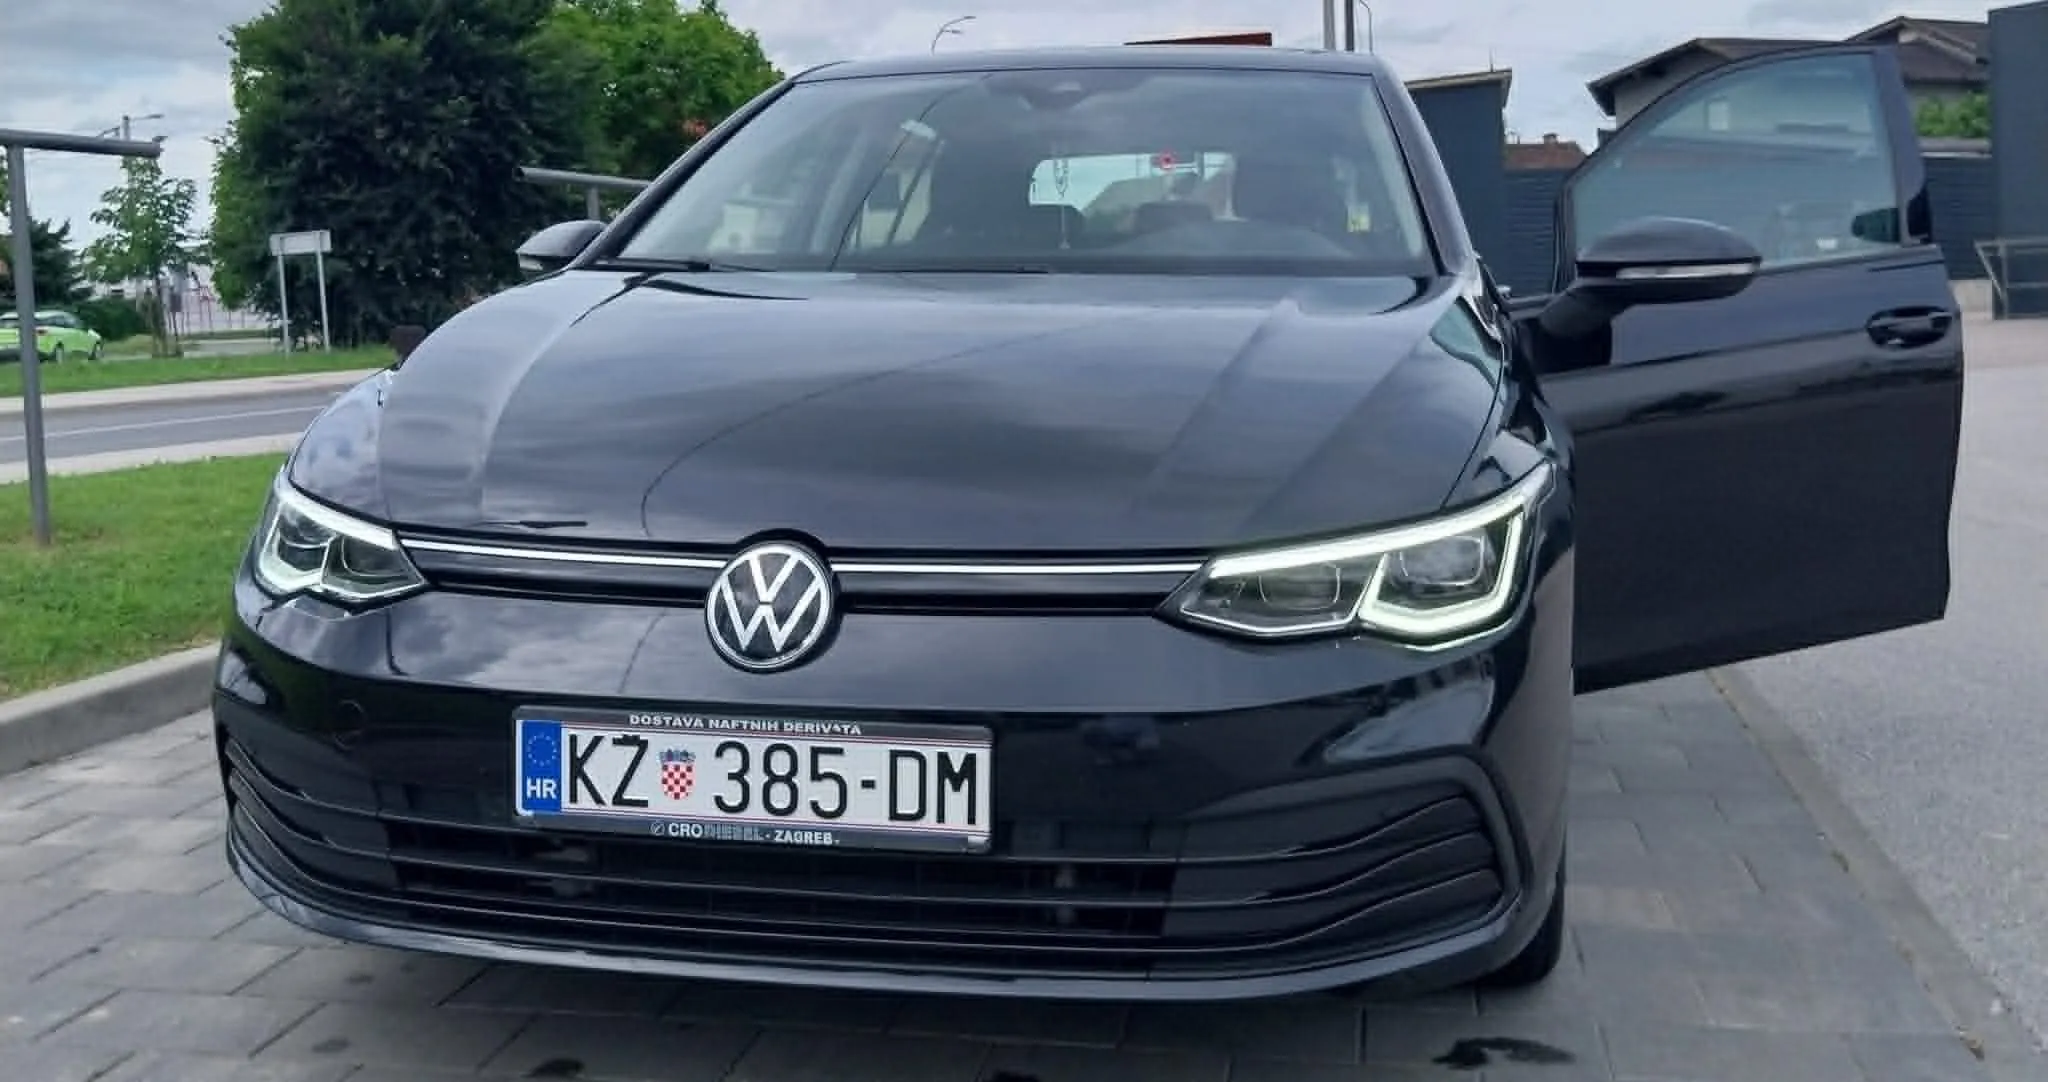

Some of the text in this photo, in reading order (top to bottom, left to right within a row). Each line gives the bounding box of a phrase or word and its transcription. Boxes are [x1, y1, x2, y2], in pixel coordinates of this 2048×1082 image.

[720, 552, 823, 653] VW
[629, 714, 862, 736] DOSTAVA NAFTNIH DERIVATA
[526, 777, 557, 798] HR
[569, 734, 977, 825] KŽ 385-DM
